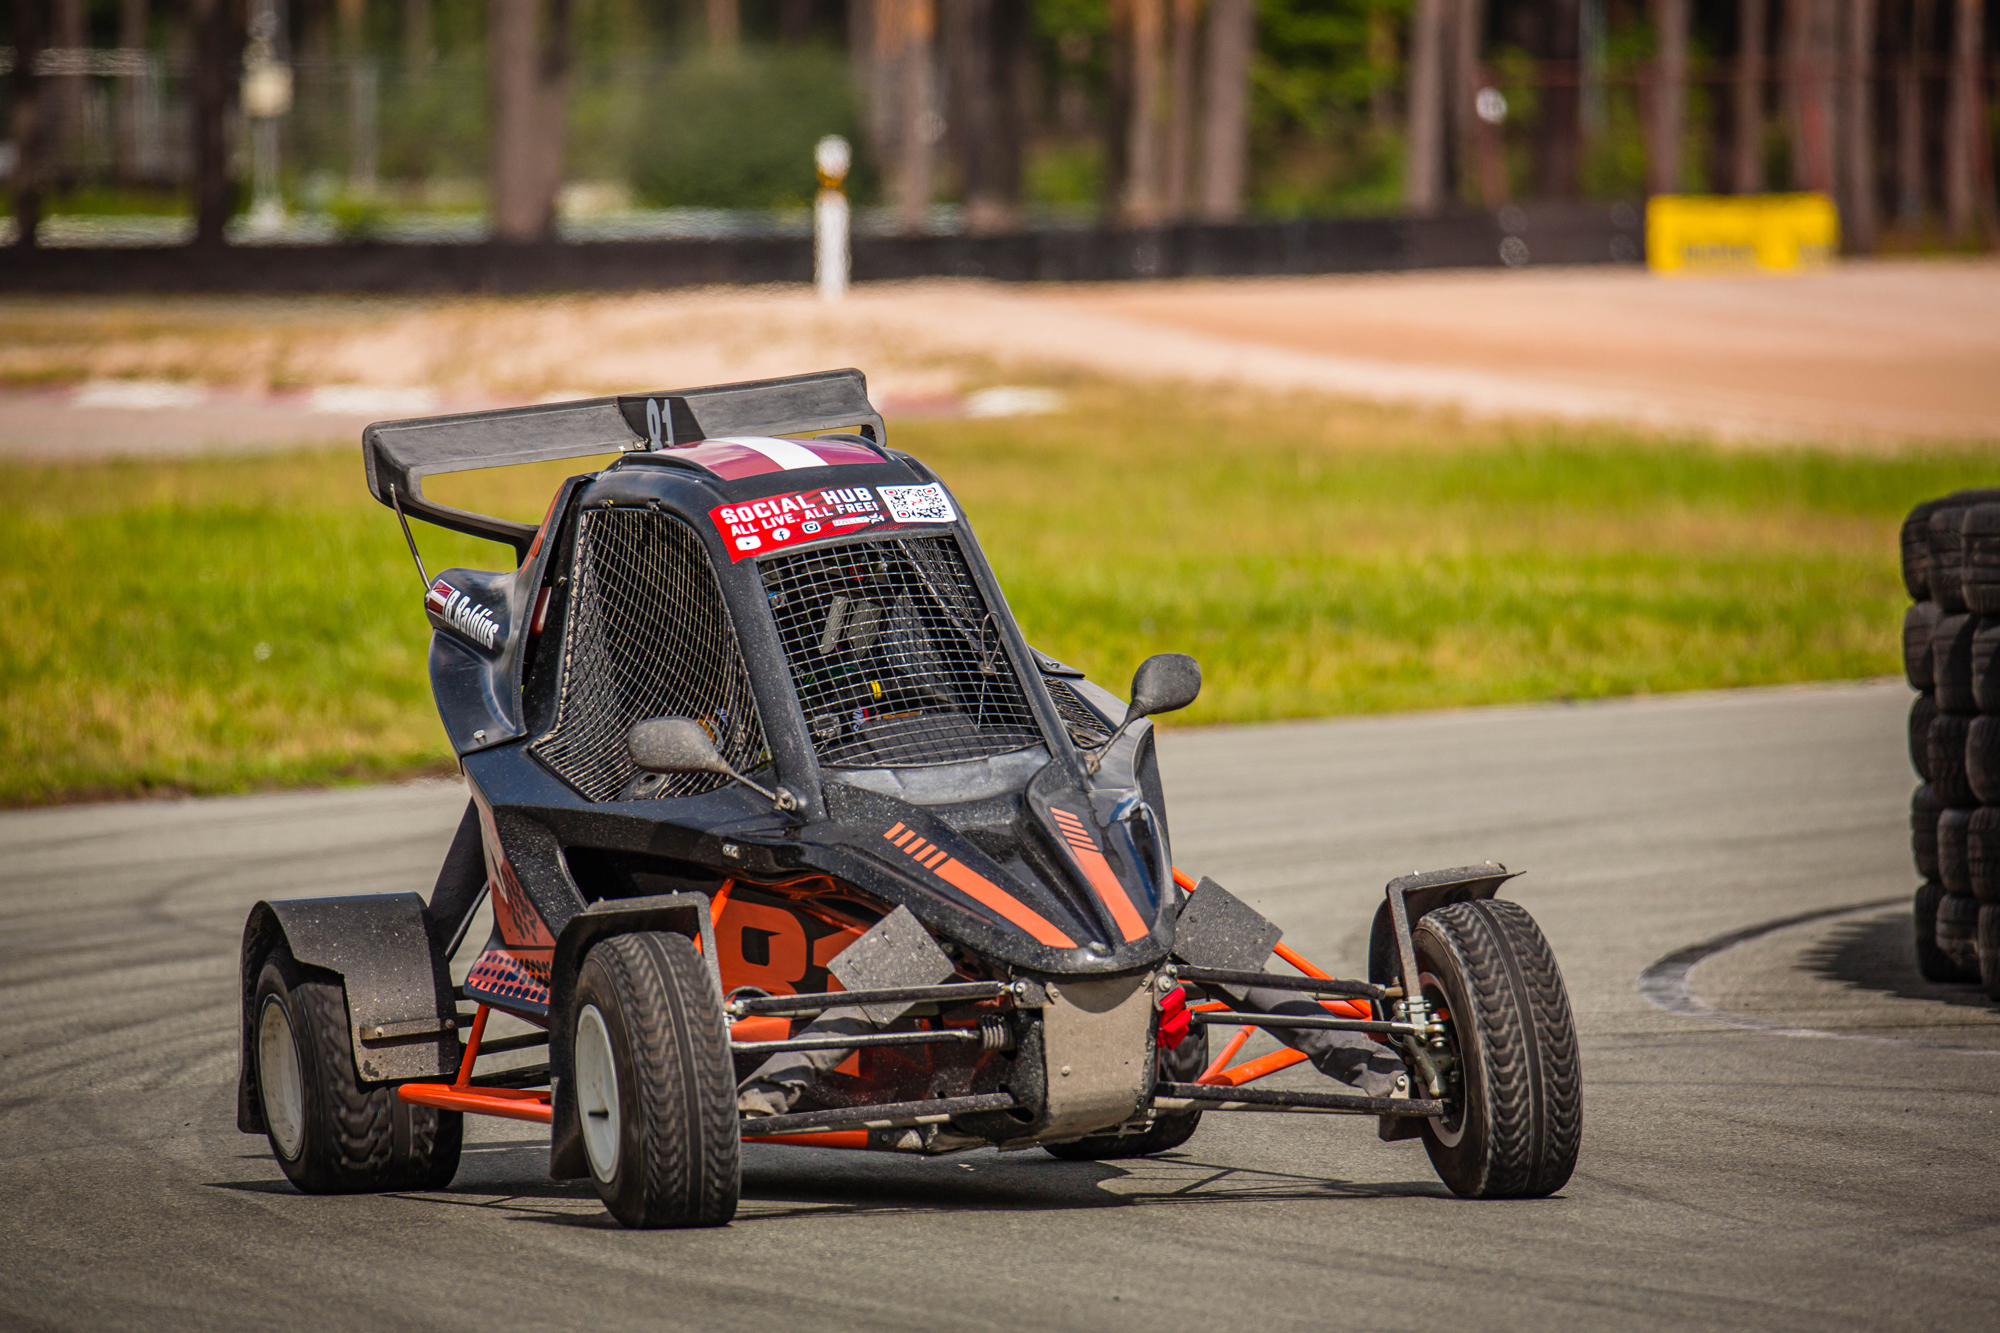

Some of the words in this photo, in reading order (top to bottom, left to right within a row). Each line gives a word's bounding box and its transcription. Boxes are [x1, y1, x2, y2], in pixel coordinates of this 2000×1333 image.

[720, 495, 816, 524] SOCIAL
[820, 487, 873, 505] HUB
[730, 524, 760, 537] ALL
[761, 513, 800, 529] LIVE.
[804, 507, 834, 520] ALL
[835, 501, 880, 515] FREE!
